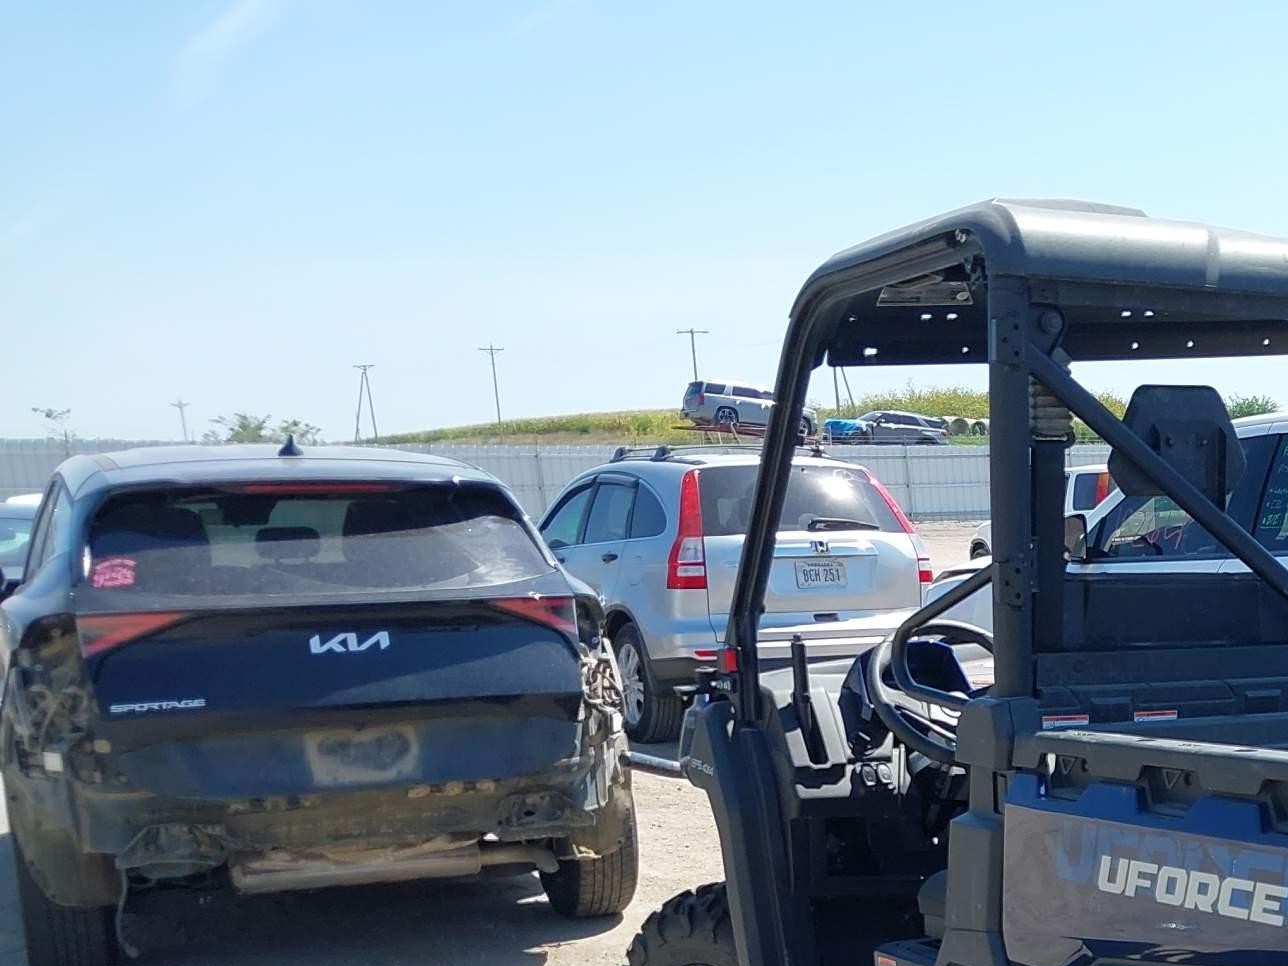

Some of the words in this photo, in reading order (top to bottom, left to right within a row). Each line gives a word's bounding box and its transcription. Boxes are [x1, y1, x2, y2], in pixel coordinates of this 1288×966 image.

[823, 568, 841, 582] 251
[309, 631, 390, 654] KIA
[109, 698, 206, 713] SPORTAGE
[1098, 855, 1288, 927] UFORCE
